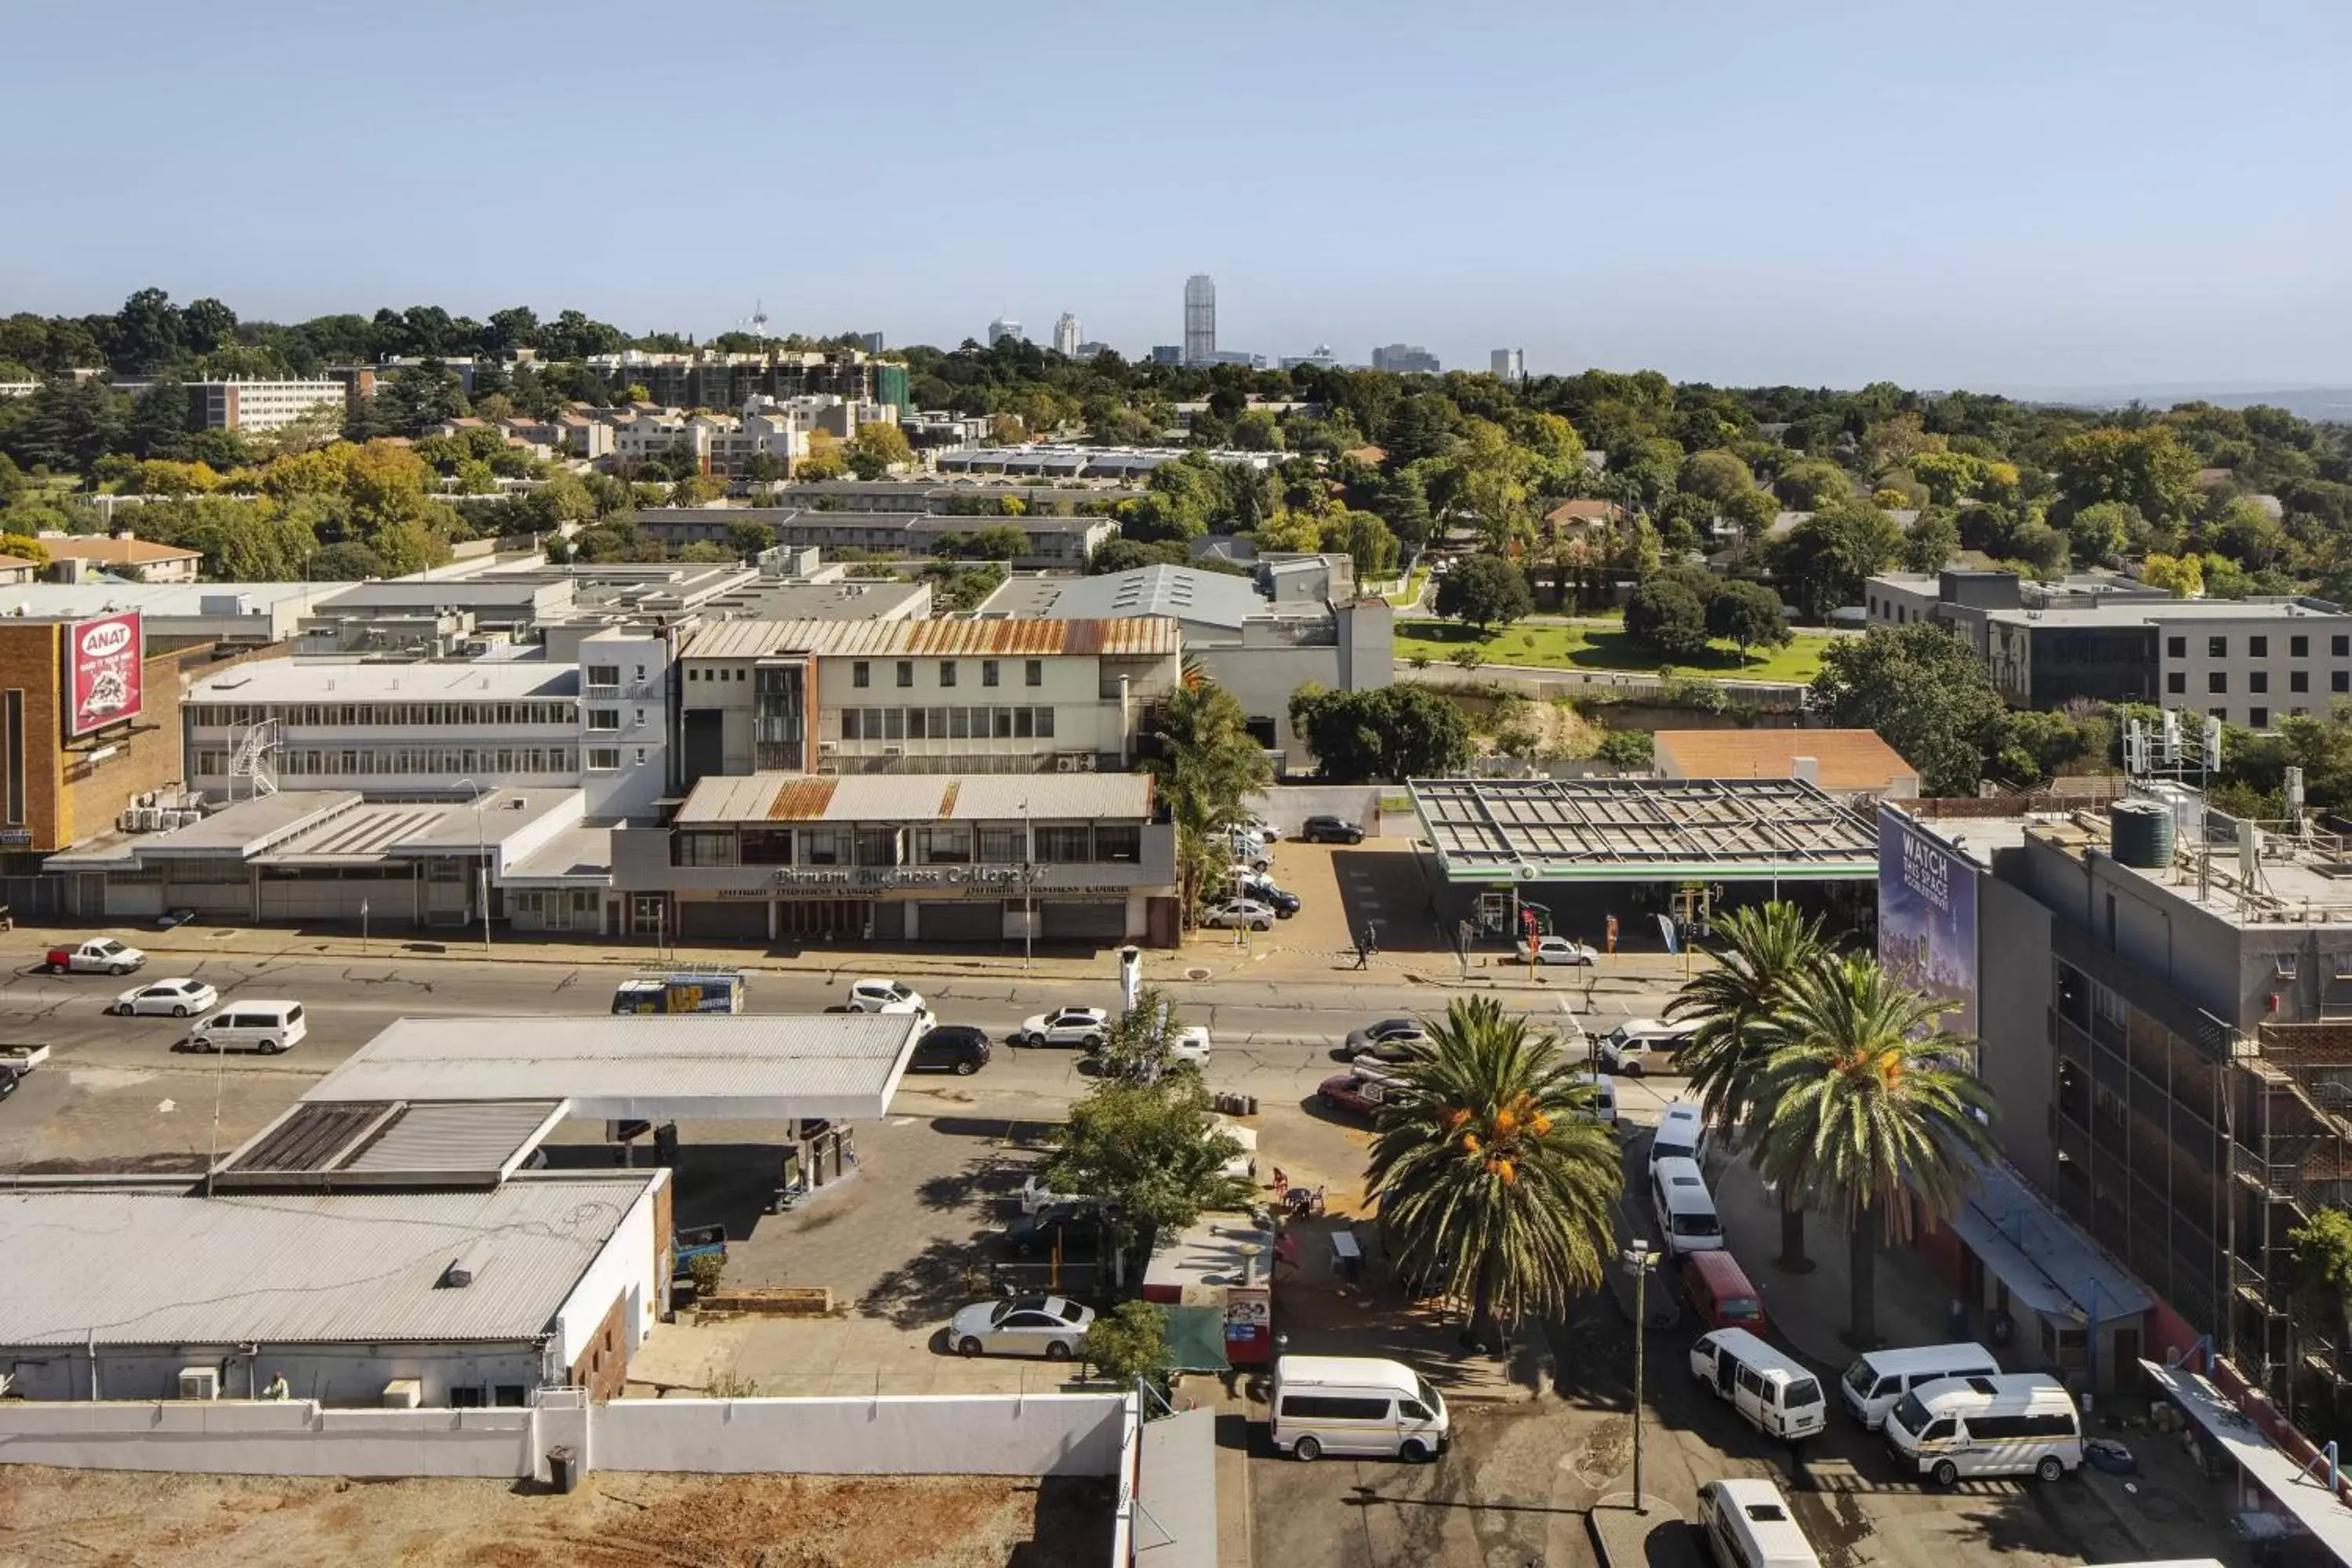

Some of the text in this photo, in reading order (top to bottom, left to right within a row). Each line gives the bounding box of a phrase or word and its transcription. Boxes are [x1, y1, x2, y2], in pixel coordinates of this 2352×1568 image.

[86, 628, 126, 651] ANAT
[1903, 831, 1947, 882] WATCH
[773, 866, 849, 885] Birnam
[946, 866, 1020, 884] College
